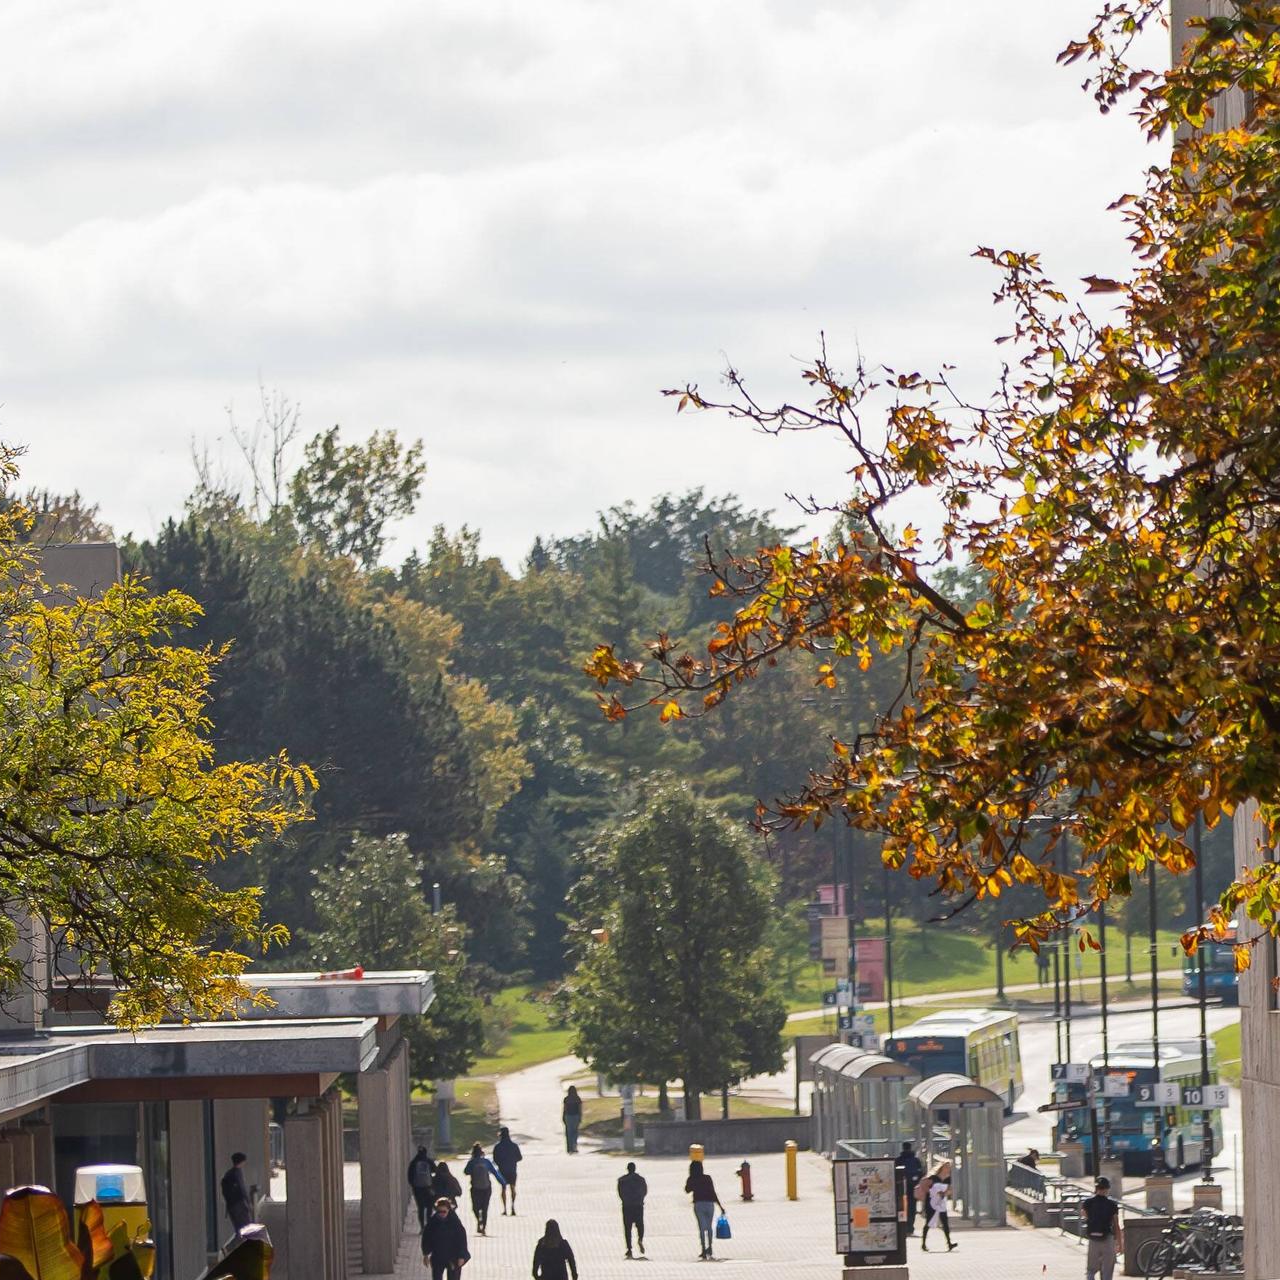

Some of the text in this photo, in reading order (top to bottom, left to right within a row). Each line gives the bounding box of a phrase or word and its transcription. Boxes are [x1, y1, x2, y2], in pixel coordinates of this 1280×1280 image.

[1054, 1068, 1063, 1078] 7
[1140, 1088, 1150, 1101] 9
[1184, 1090, 1224, 1104] 10 15
